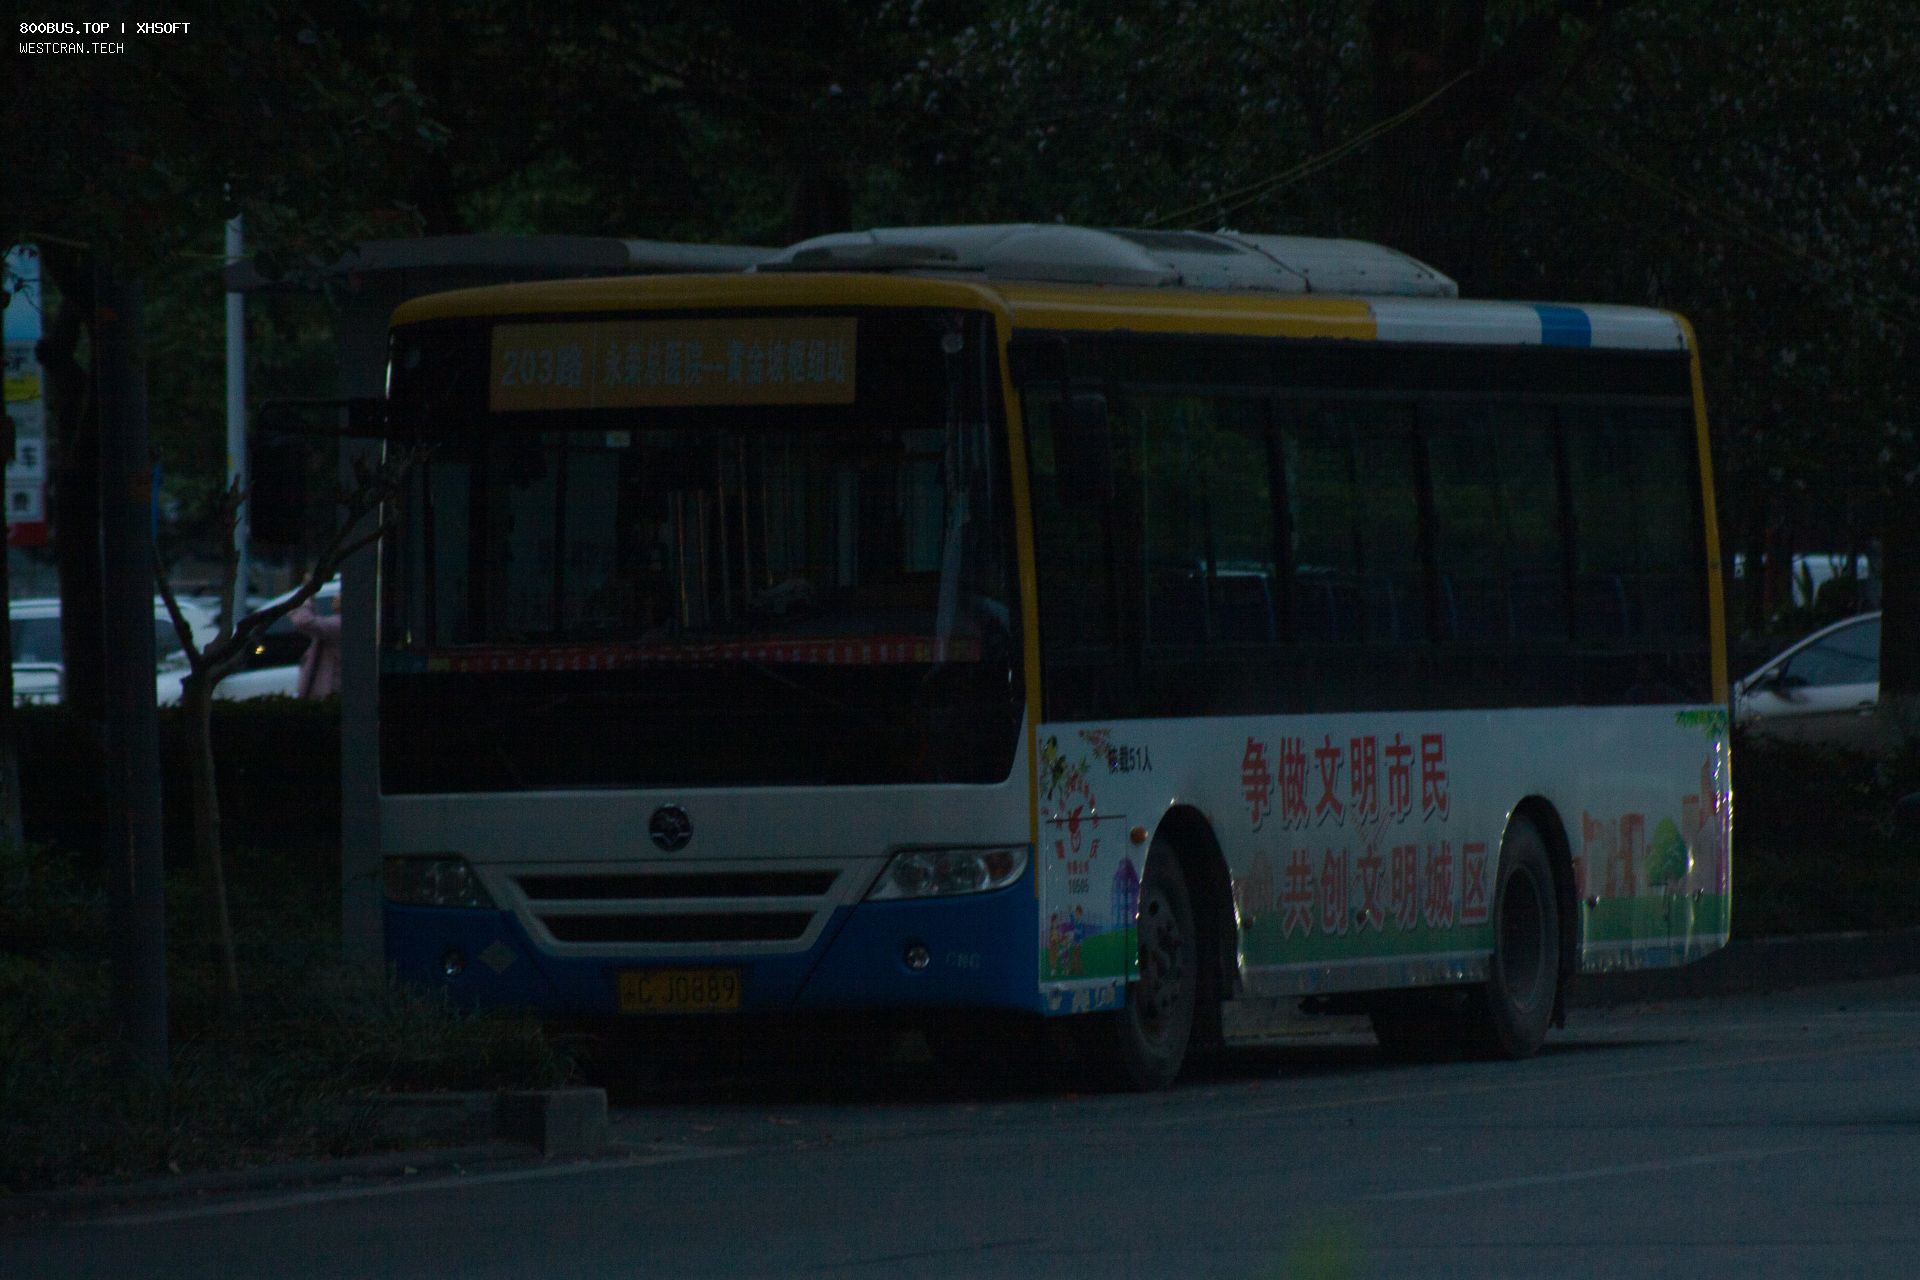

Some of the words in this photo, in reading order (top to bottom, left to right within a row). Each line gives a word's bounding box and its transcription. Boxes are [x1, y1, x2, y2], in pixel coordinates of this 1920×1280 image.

[500, 342, 584, 389] 203路
[1241, 732, 1450, 832] 争做文明市民
[1281, 840, 1489, 940] 共创文明城区
